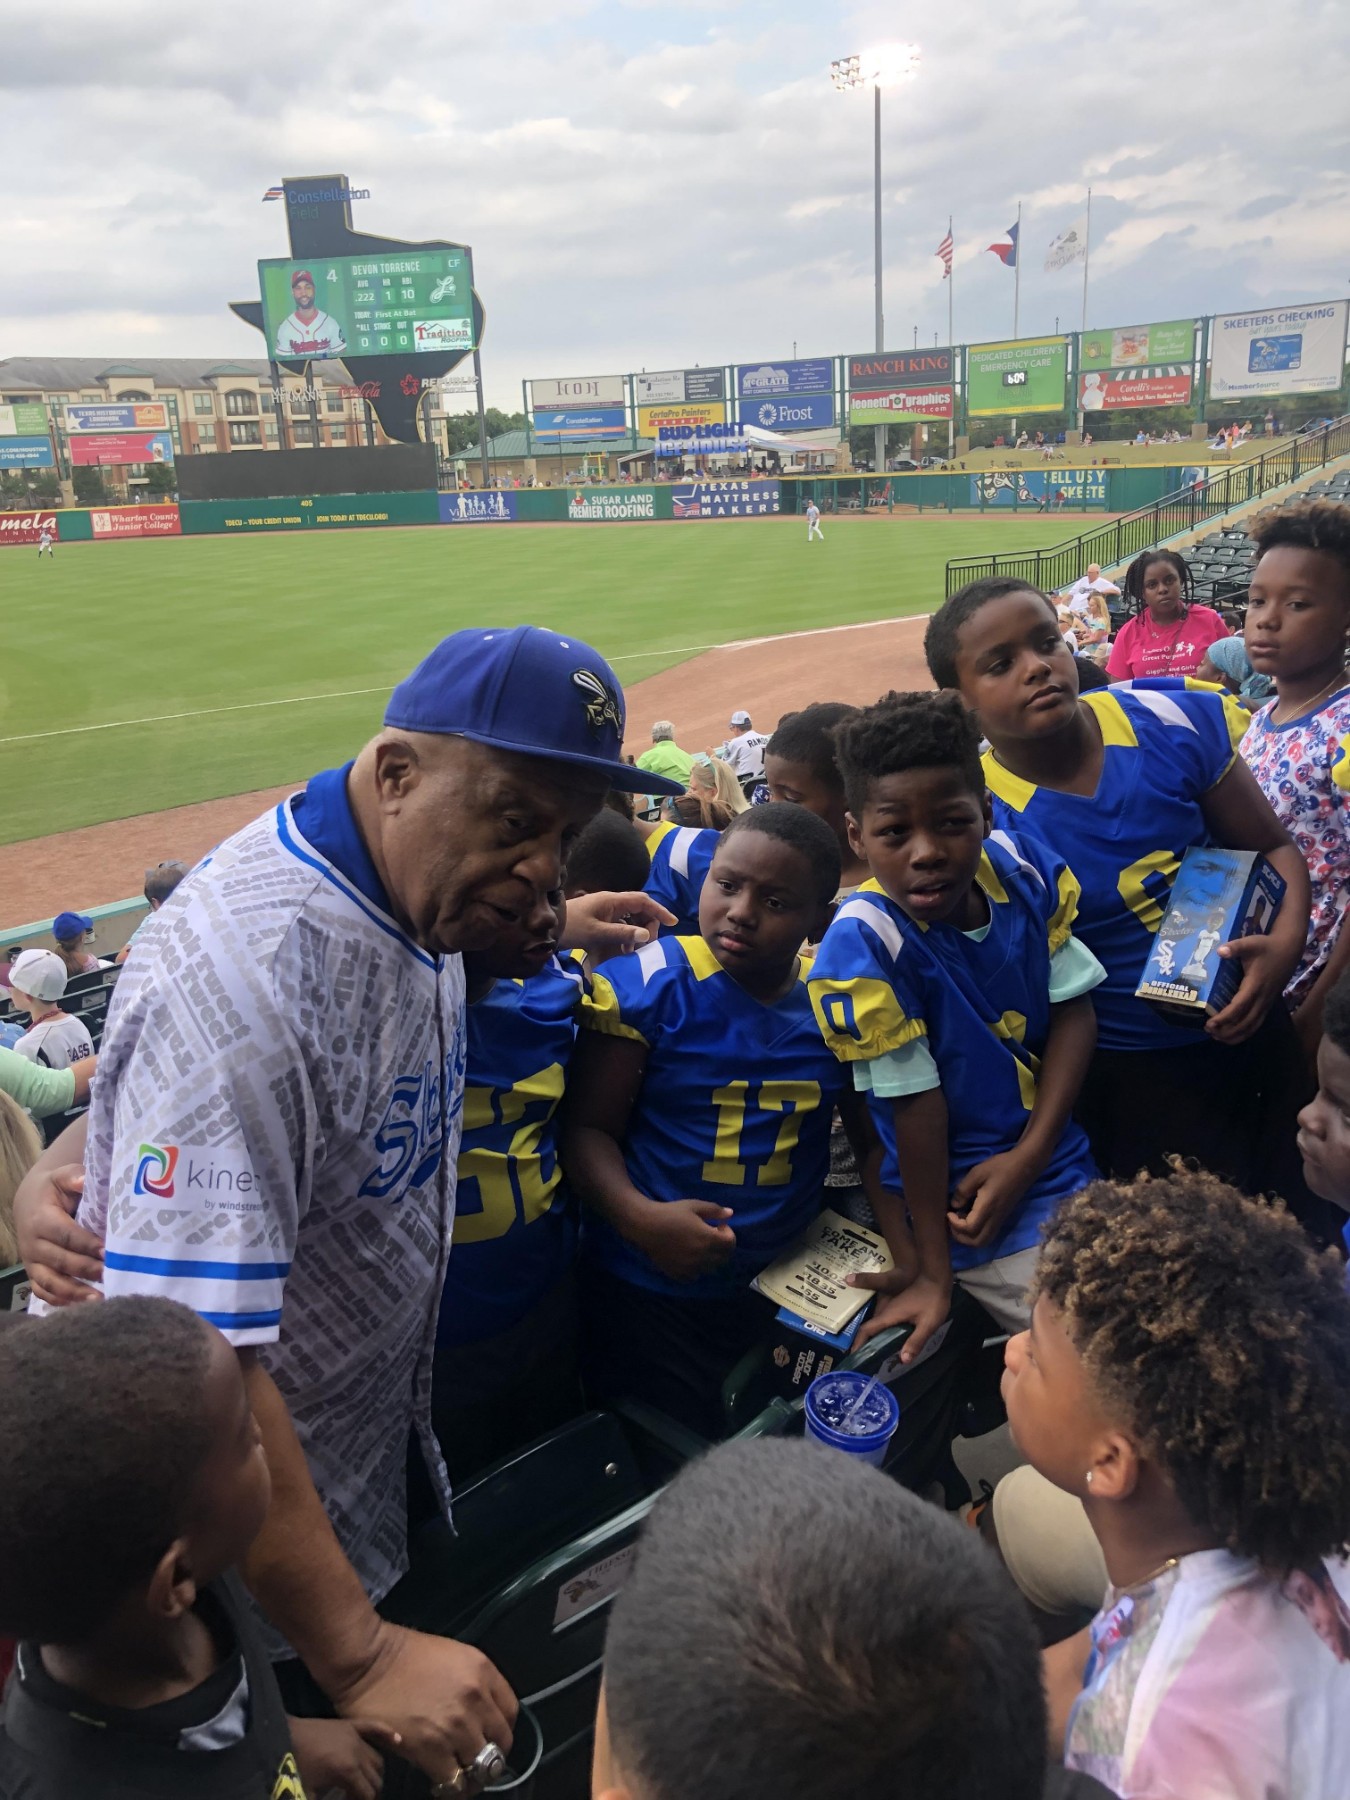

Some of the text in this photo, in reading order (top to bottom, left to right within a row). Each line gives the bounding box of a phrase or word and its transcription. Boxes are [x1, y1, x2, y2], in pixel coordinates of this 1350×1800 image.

[288, 187, 370, 204] Constellation
[290, 206, 318, 220] Field
[352, 261, 420, 276] DEVON TORRENCE
[448, 259, 460, 268] CF
[326, 269, 338, 282] 4
[357, 280, 369, 288] AVG
[402, 277, 412, 285] RBI
[385, 291, 391, 300] 1
[401, 289, 415, 299] 10
[1223, 307, 1335, 330] SKEETERS CHECKING
[415, 326, 468, 340] Tradition
[361, 335, 407, 347] 0 0 0
[971, 345, 1063, 363] DEDICATED CHILDREN'S
[852, 356, 949, 376] RANCH KING
[980, 358, 1052, 373] EMERGENCY CARE
[421, 375, 480, 388] REPUBLIC
[1120, 383, 1150, 393] Corelli's
[852, 392, 951, 410] leonetti graphics
[650, 407, 711, 419] CertaPro Painters
[779, 405, 813, 421] Frost
[658, 422, 745, 441] BUD LIGHT
[656, 439, 749, 457] ICE HOUSE
[700, 482, 749, 492] TEXAS
[591, 494, 653, 505] SUGAR LAND
[701, 491, 780, 503] MATTRESS
[568, 503, 654, 519] PREMIER ROOFING
[702, 502, 780, 516] MAKERS
[111, 514, 147, 523] Wharton
[150, 512, 178, 524] County
[248, 518, 263, 526] YOUR
[264, 517, 282, 525] CREDIT
[283, 516, 301, 524] UNION
[316, 515, 329, 523] JOIN
[330, 514, 347, 522] TODAY
[112, 521, 173, 531] Junior College
[1151, 980, 1189, 993] OFFICIAL
[701, 1080, 823, 1186] 17
[204, 1199, 216, 1210] by
[820, 1232, 862, 1260] TAKE
[823, 1225, 887, 1264] COME AND
[792, 1351, 807, 1385] DEACON
[803, 1350, 816, 1377] JONES
